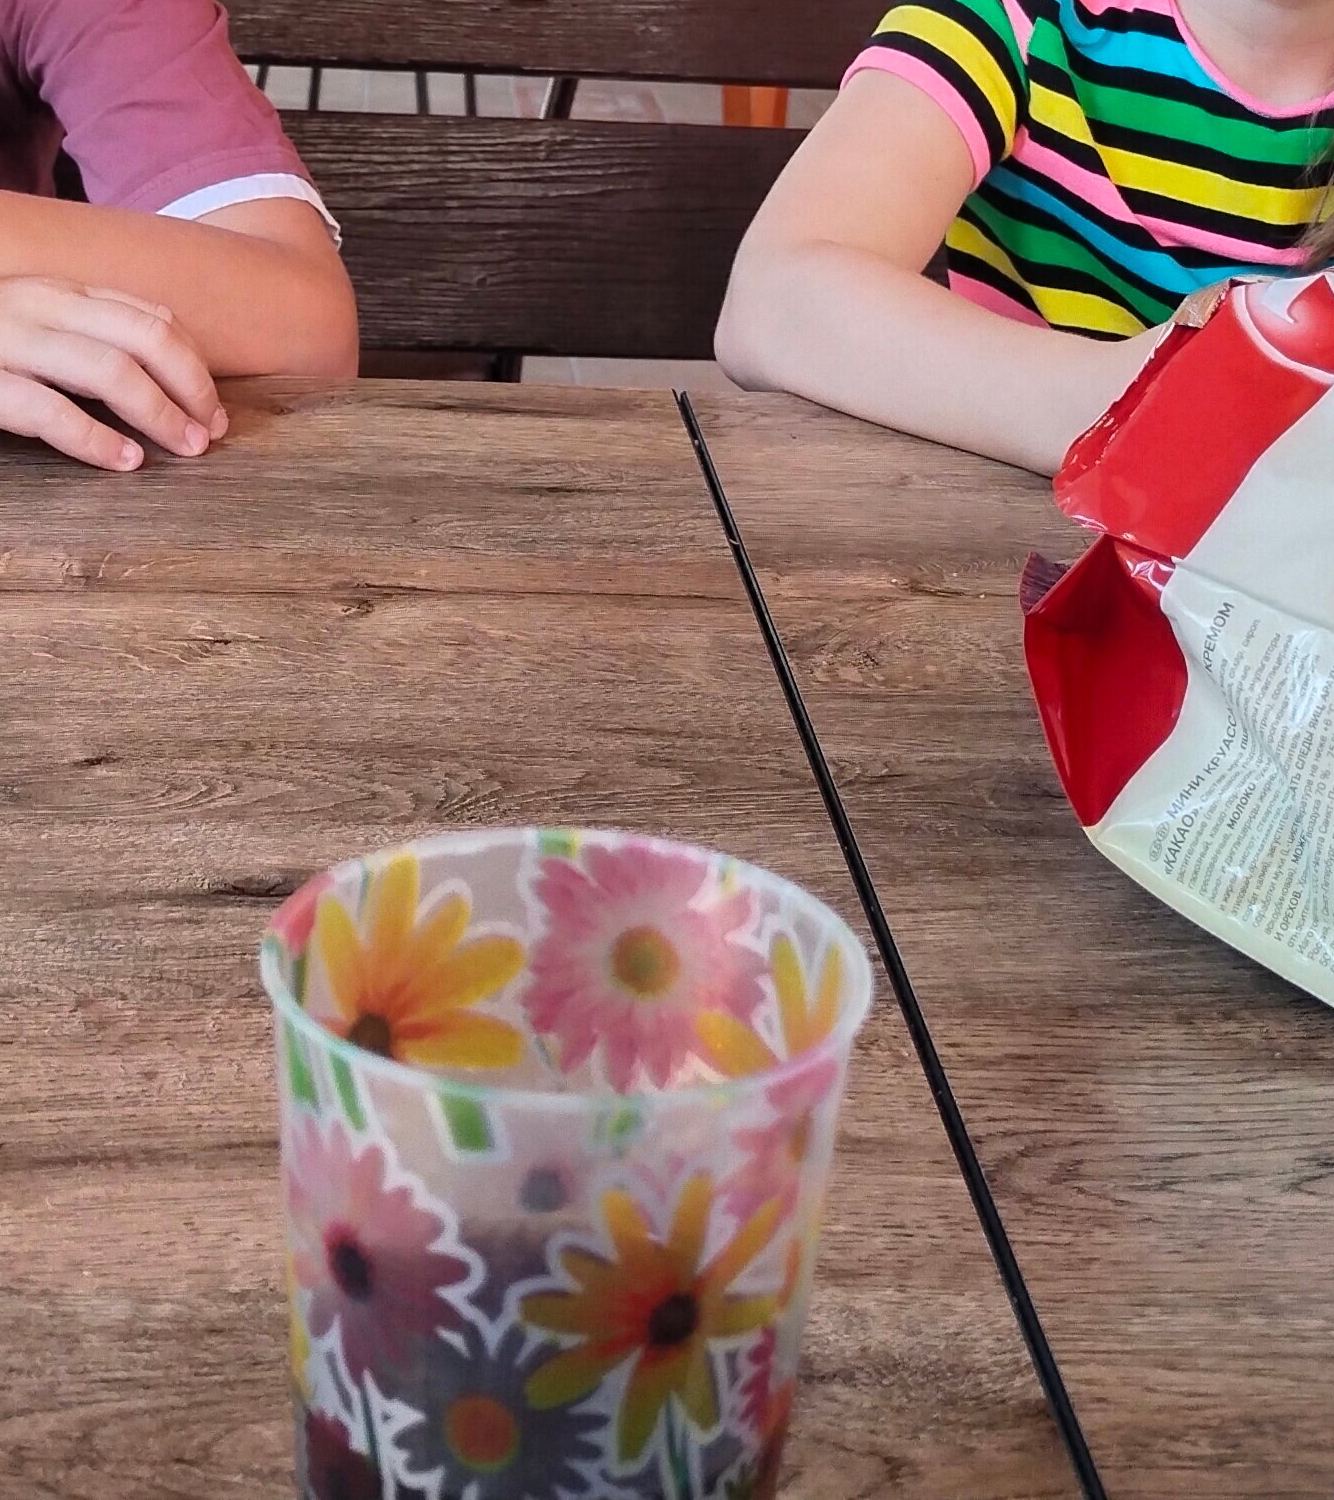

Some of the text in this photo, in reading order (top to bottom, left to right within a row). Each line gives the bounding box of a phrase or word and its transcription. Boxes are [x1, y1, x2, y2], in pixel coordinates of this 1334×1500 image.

[1164, 601, 1236, 818] МИНИ КРУАССА КРЕМОМ
[1226, 781, 1256, 829] МОЛОКО
[1247, 631, 1281, 692] эмульгаторы
[1294, 730, 1316, 770] СЛЕДЫ
[1307, 702, 1326, 729] ЯИЦ,
[1163, 806, 1201, 875] «КАКАО».
[1278, 887, 1303, 931] ОРЕХОВ.
[1313, 734, 1328, 762] ниже
[1304, 798, 1324, 838] воздуха
[1175, 821, 1207, 884] растительные
[1272, 857, 1286, 881] муки
